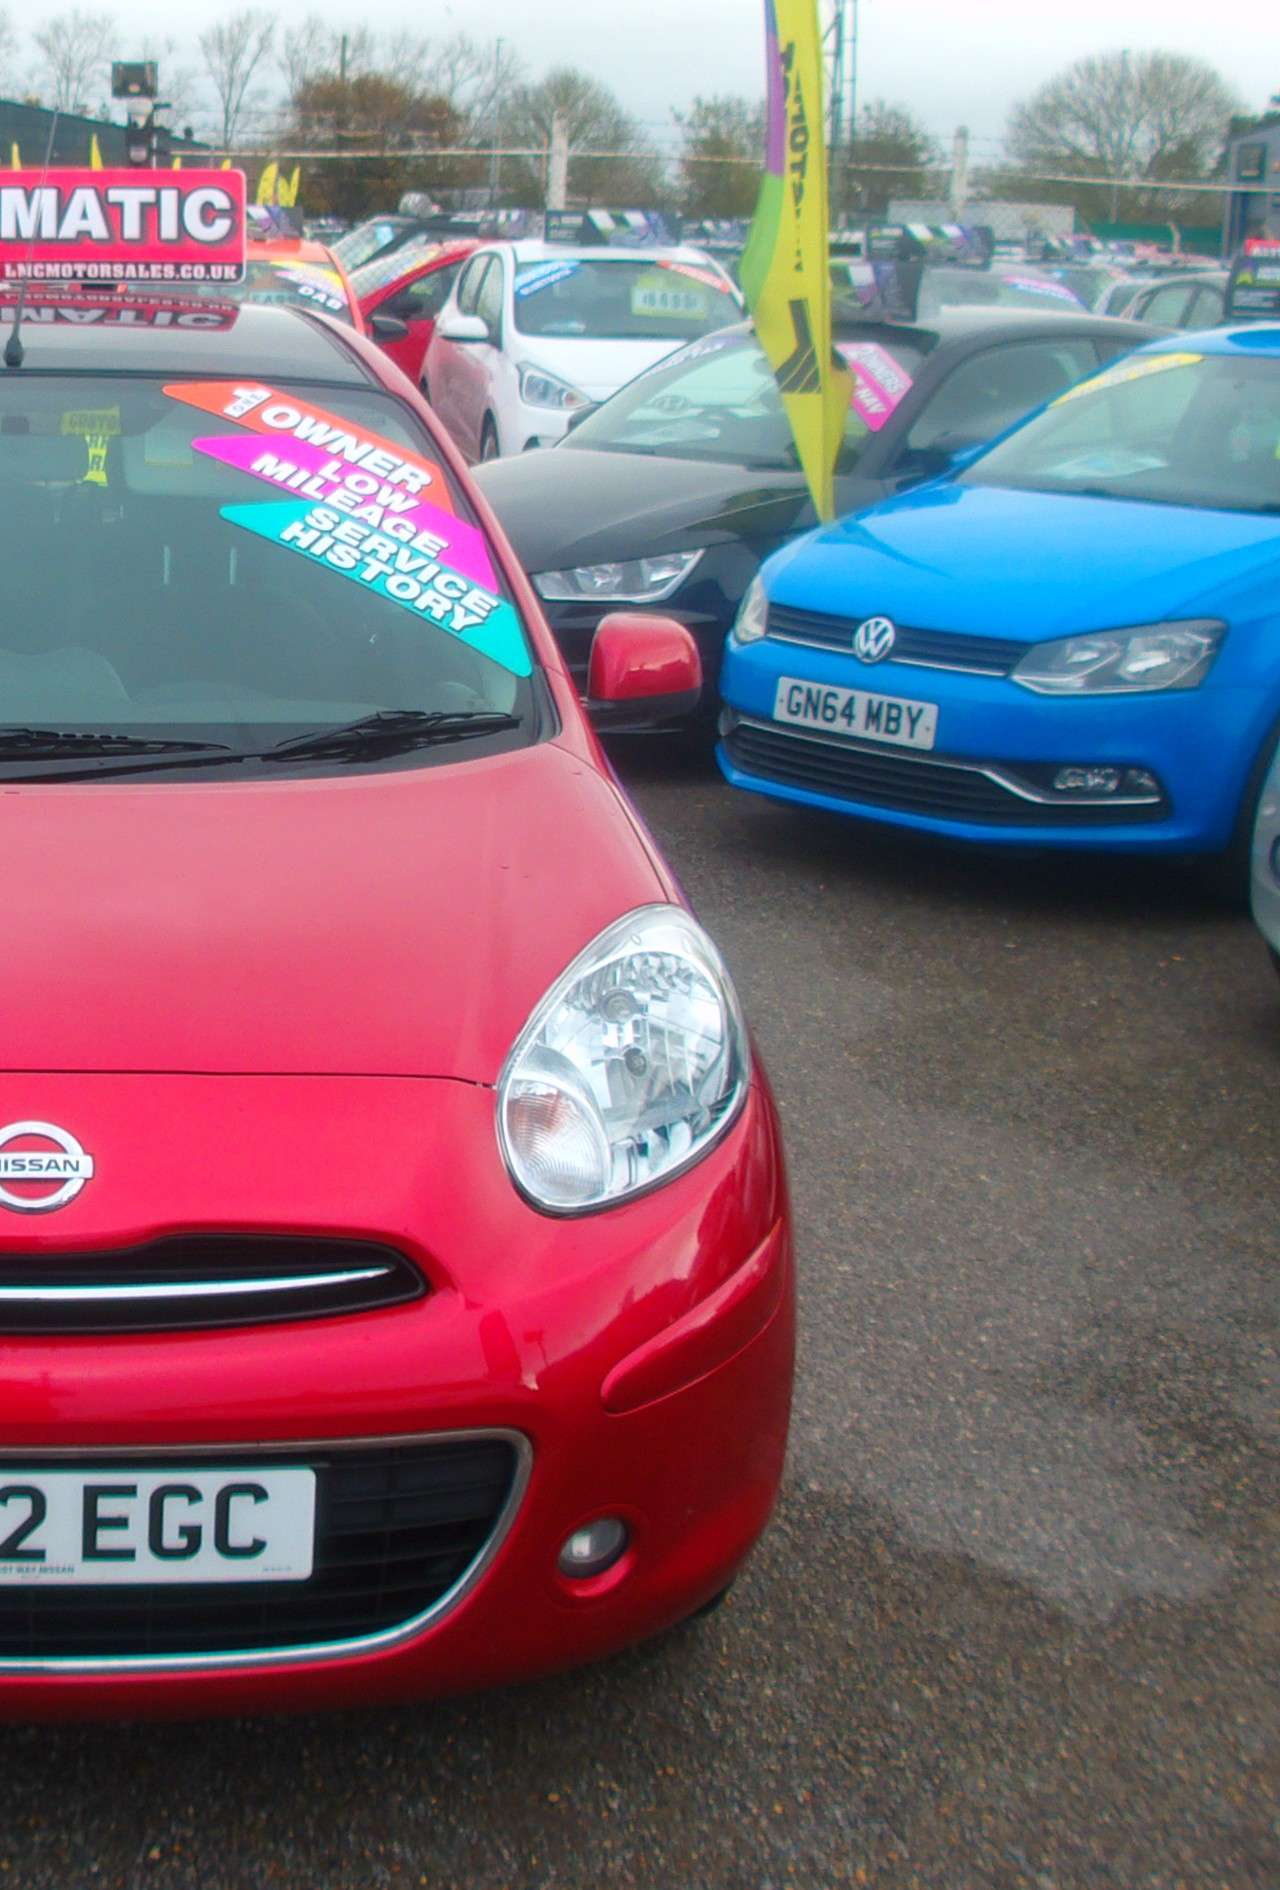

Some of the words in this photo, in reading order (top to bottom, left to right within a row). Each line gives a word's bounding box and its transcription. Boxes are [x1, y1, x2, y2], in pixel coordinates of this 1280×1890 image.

[5, 262, 237, 279] LMCMOTORSALES.CO.UK
[223, 387, 273, 419] 1
[261, 406, 433, 493] OWNER
[250, 454, 450, 560] MILEAGE
[318, 460, 421, 514] LOW
[279, 522, 486, 633] HISTORY
[304, 506, 499, 617] SERVICE
[786, 685, 856, 728] GN64
[864, 699, 924, 739] MBY
[81, 1482, 270, 1563] EGC
